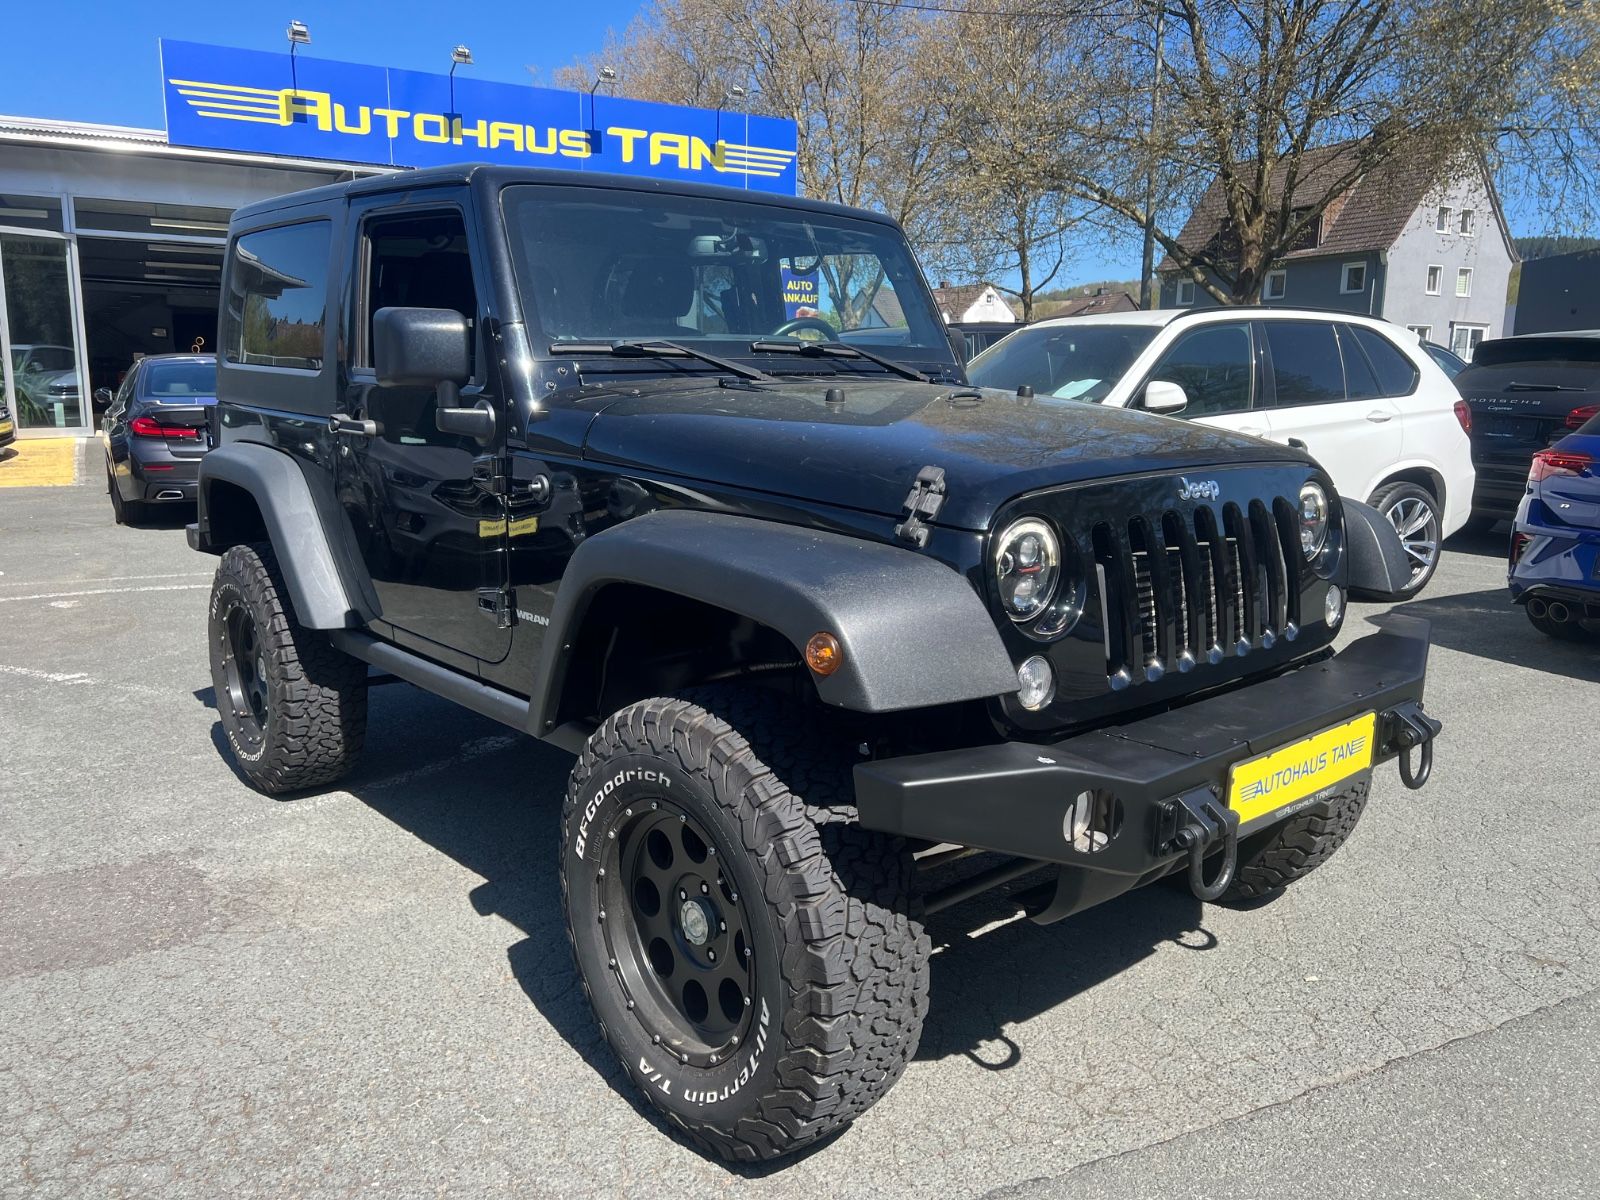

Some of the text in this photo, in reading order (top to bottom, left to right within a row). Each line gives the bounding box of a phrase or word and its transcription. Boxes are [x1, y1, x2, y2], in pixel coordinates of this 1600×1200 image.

[280, 88, 726, 172] AUTOHAUS TAN
[787, 280, 813, 291] AUTO
[1469, 398, 1541, 406] PORSCHE
[1178, 476, 1220, 502] Jeep
[516, 608, 550, 627] WRAN
[1254, 740, 1356, 799] AUTOHAUS TAN
[575, 766, 672, 861] BFGoodrich
[638, 996, 771, 1107] All-Terrain T/A
